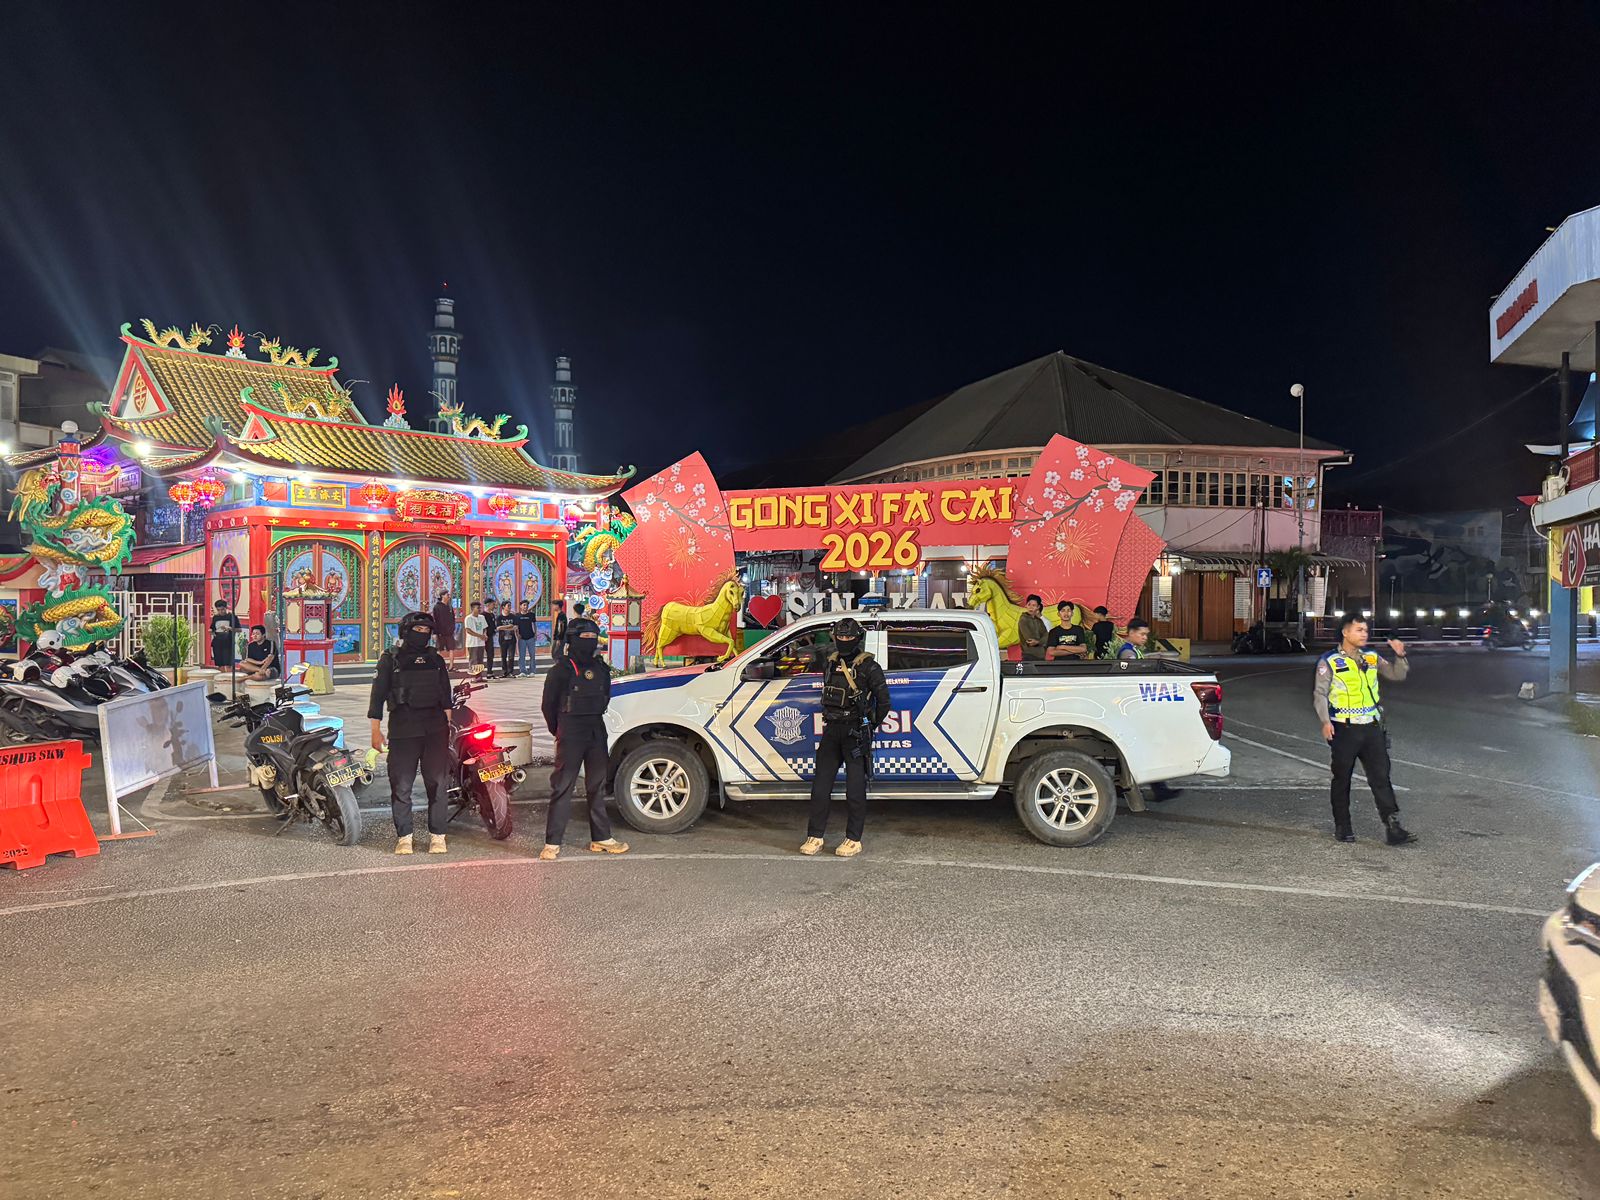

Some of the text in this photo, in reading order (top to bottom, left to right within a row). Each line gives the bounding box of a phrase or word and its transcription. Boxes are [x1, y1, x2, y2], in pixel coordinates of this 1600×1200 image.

[729, 487, 1014, 529] GONG XI FA CAI
[822, 530, 918, 568] 2026
[1139, 683, 1184, 701] WAL
[260, 735, 283, 743] POLISI
[39, 749, 65, 760] SKW
[3, 848, 28, 858] 2022
